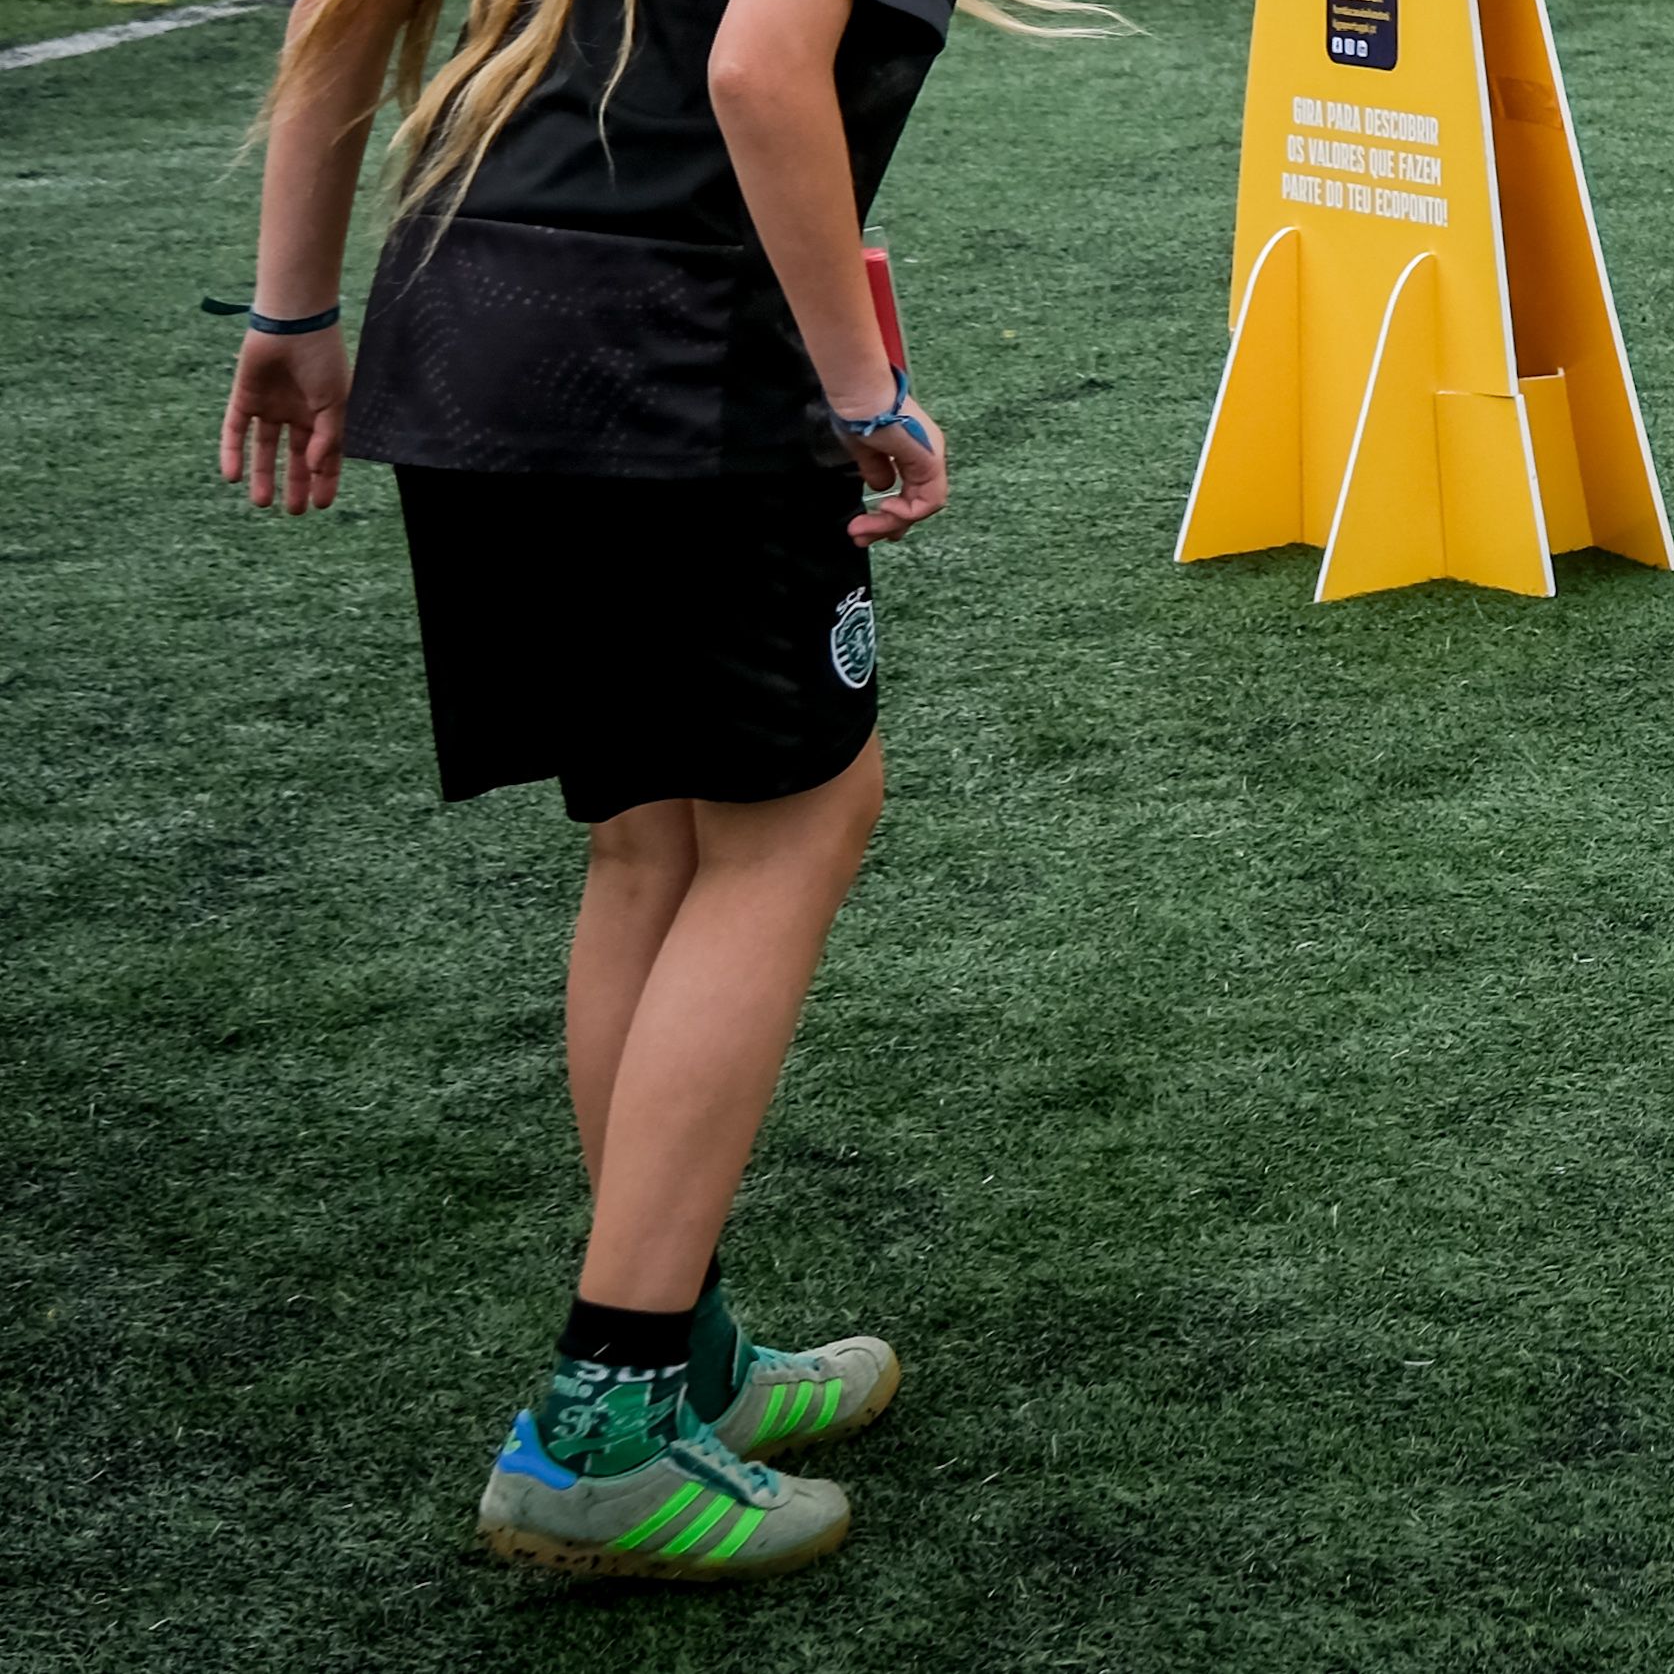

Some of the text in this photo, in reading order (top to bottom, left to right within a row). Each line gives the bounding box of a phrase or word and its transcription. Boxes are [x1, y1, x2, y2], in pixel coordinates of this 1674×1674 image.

[1293, 96, 1439, 146] GIRA PARA DESCOBRIR
[1287, 134, 1441, 187] OS VALORES QUE FAZEM
[1281, 172, 1448, 228] PARTE DO TEU ECOPONTO!
